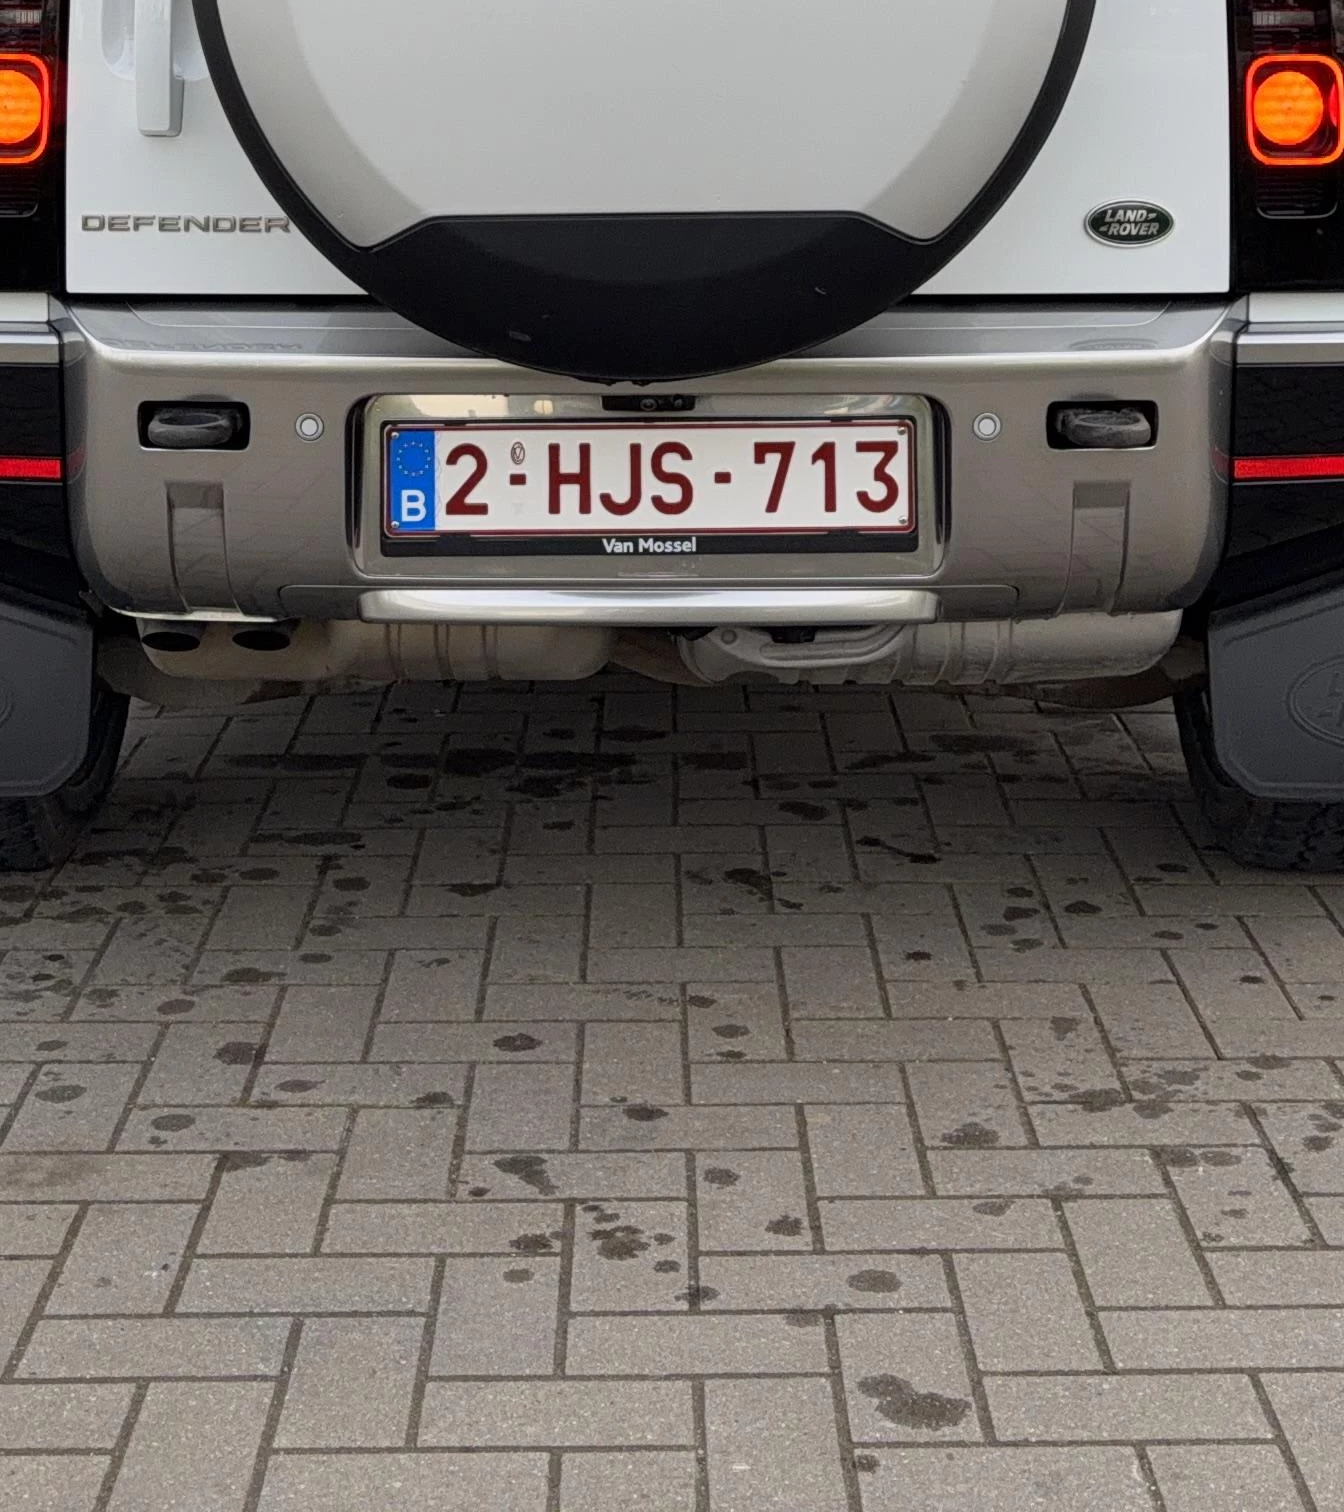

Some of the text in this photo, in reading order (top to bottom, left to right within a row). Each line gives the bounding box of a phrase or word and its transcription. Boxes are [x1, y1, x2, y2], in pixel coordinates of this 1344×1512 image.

[81, 214, 291, 234] DEFENDER
[1104, 209, 1147, 222] LAND
[1107, 222, 1160, 236] ROVER
[401, 489, 427, 522] B
[602, 536, 697, 554] Van Mossel
